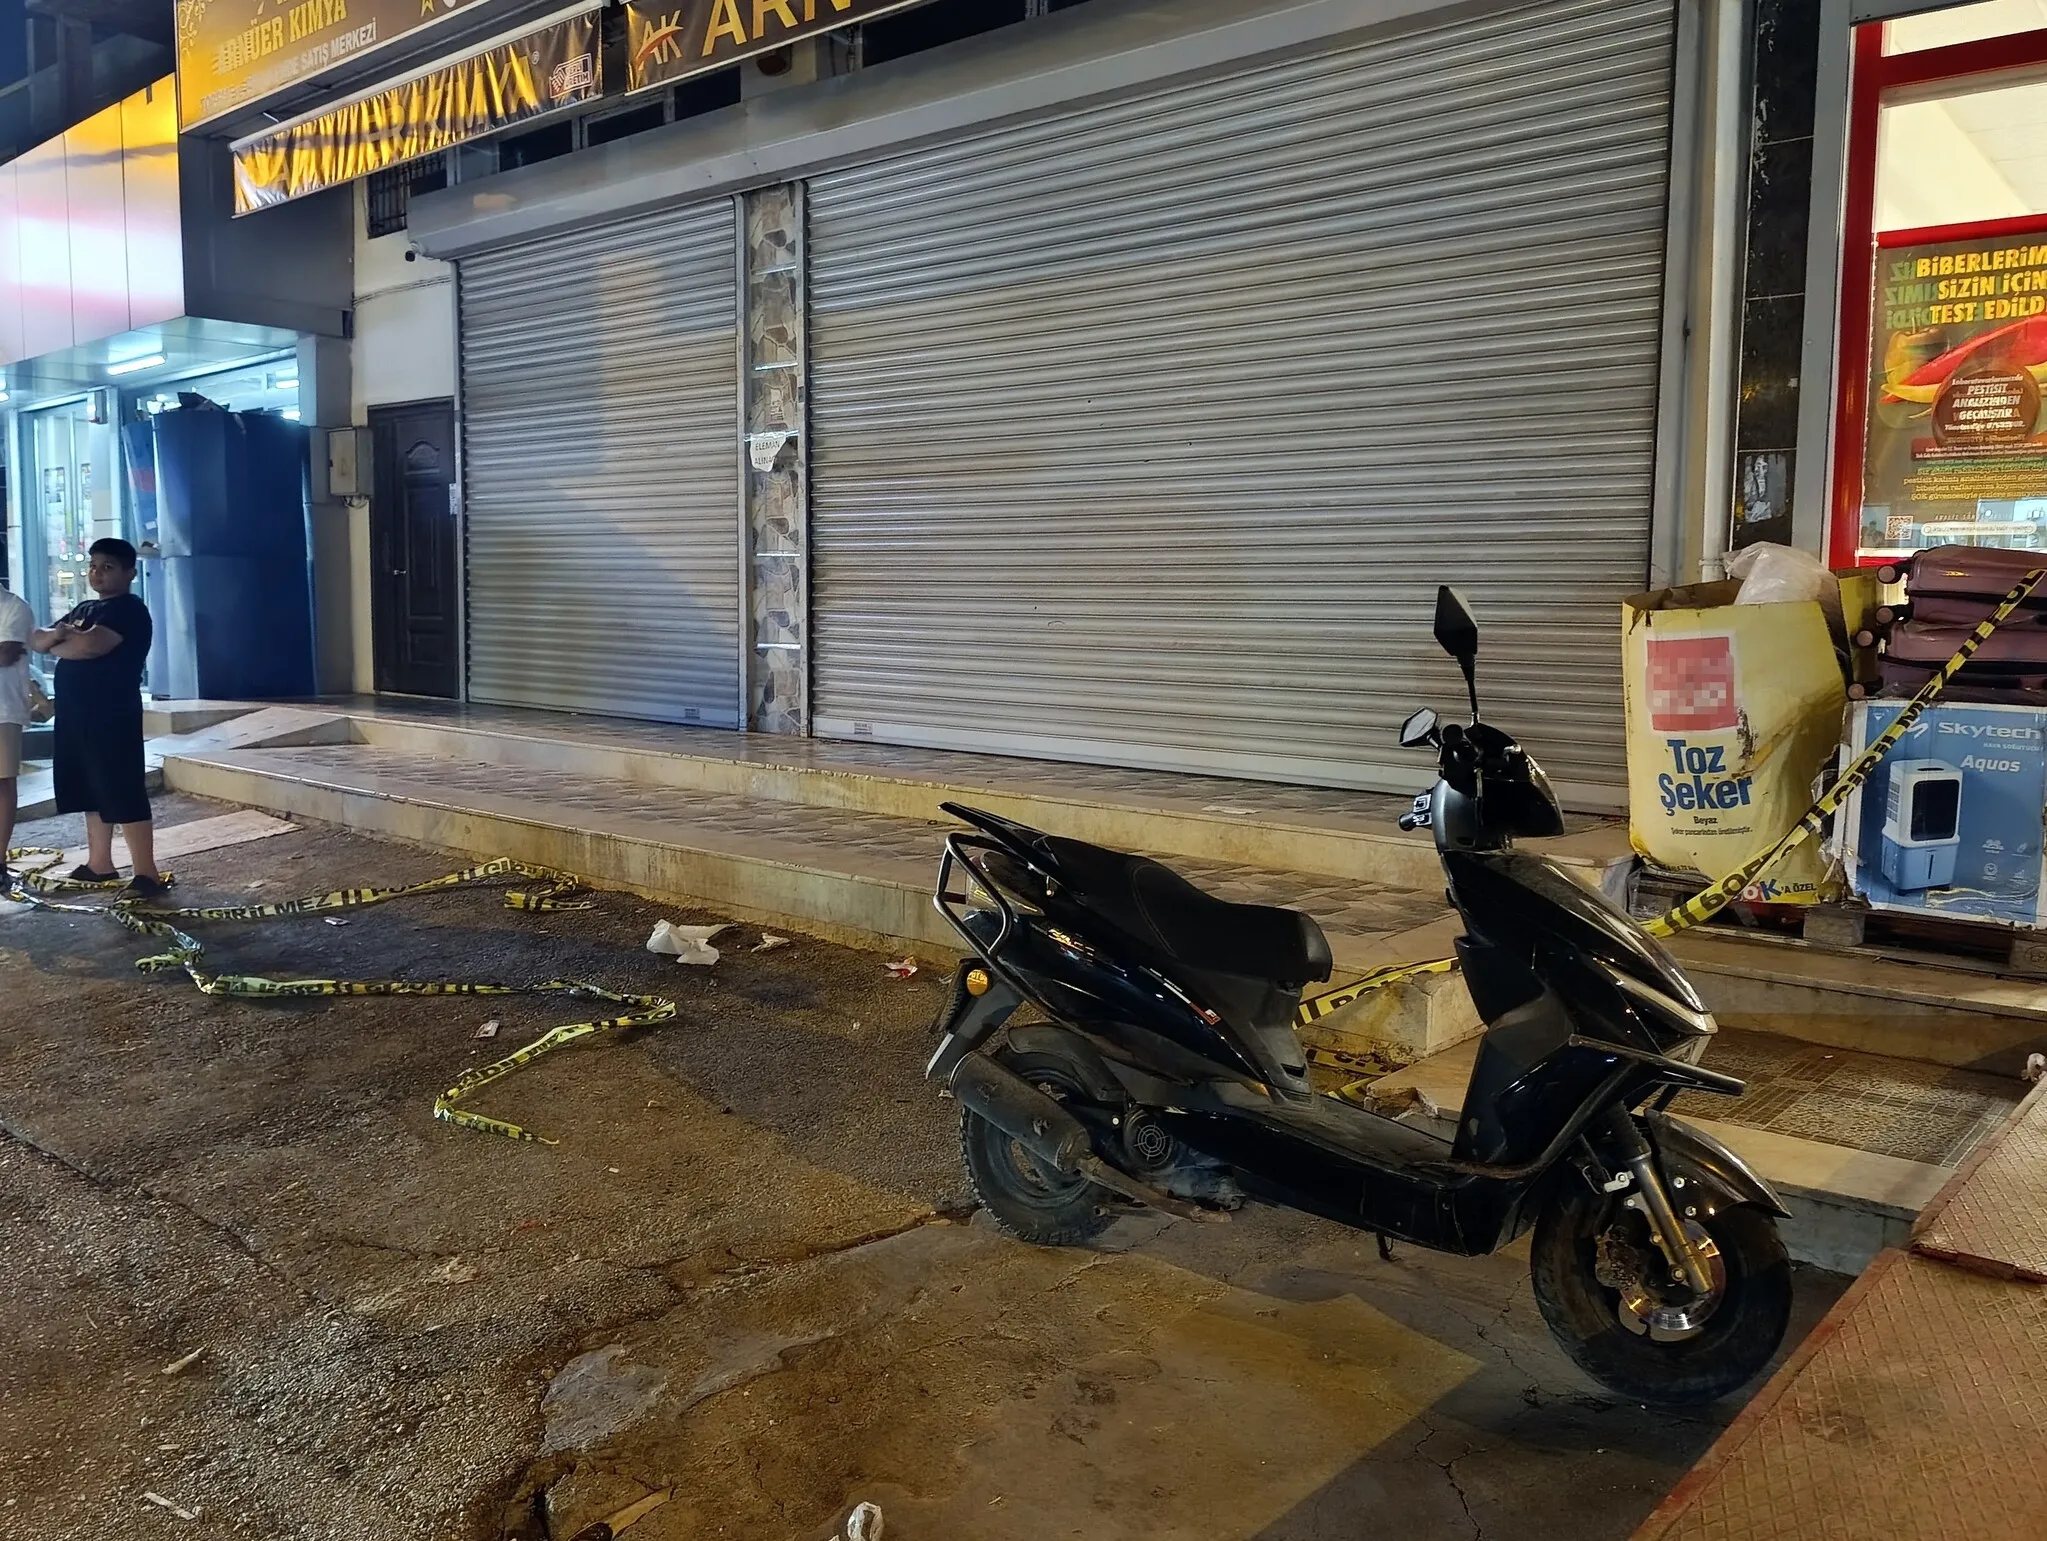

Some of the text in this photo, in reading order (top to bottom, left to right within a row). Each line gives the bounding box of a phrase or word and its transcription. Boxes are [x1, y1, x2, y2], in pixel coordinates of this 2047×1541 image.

[330, 17, 377, 56] MERKEZİ
[1929, 302, 1977, 325] TEST
[755, 440, 780, 451] ELEMAN
[1938, 721, 2041, 739] Skytech
[1667, 739, 1726, 775] Toz
[1960, 754, 2021, 773] Aquos
[1658, 773, 1753, 817] Şeker
[1693, 816, 1718, 826] Beyaz
[1793, 882, 1817, 892] ÖZEL
